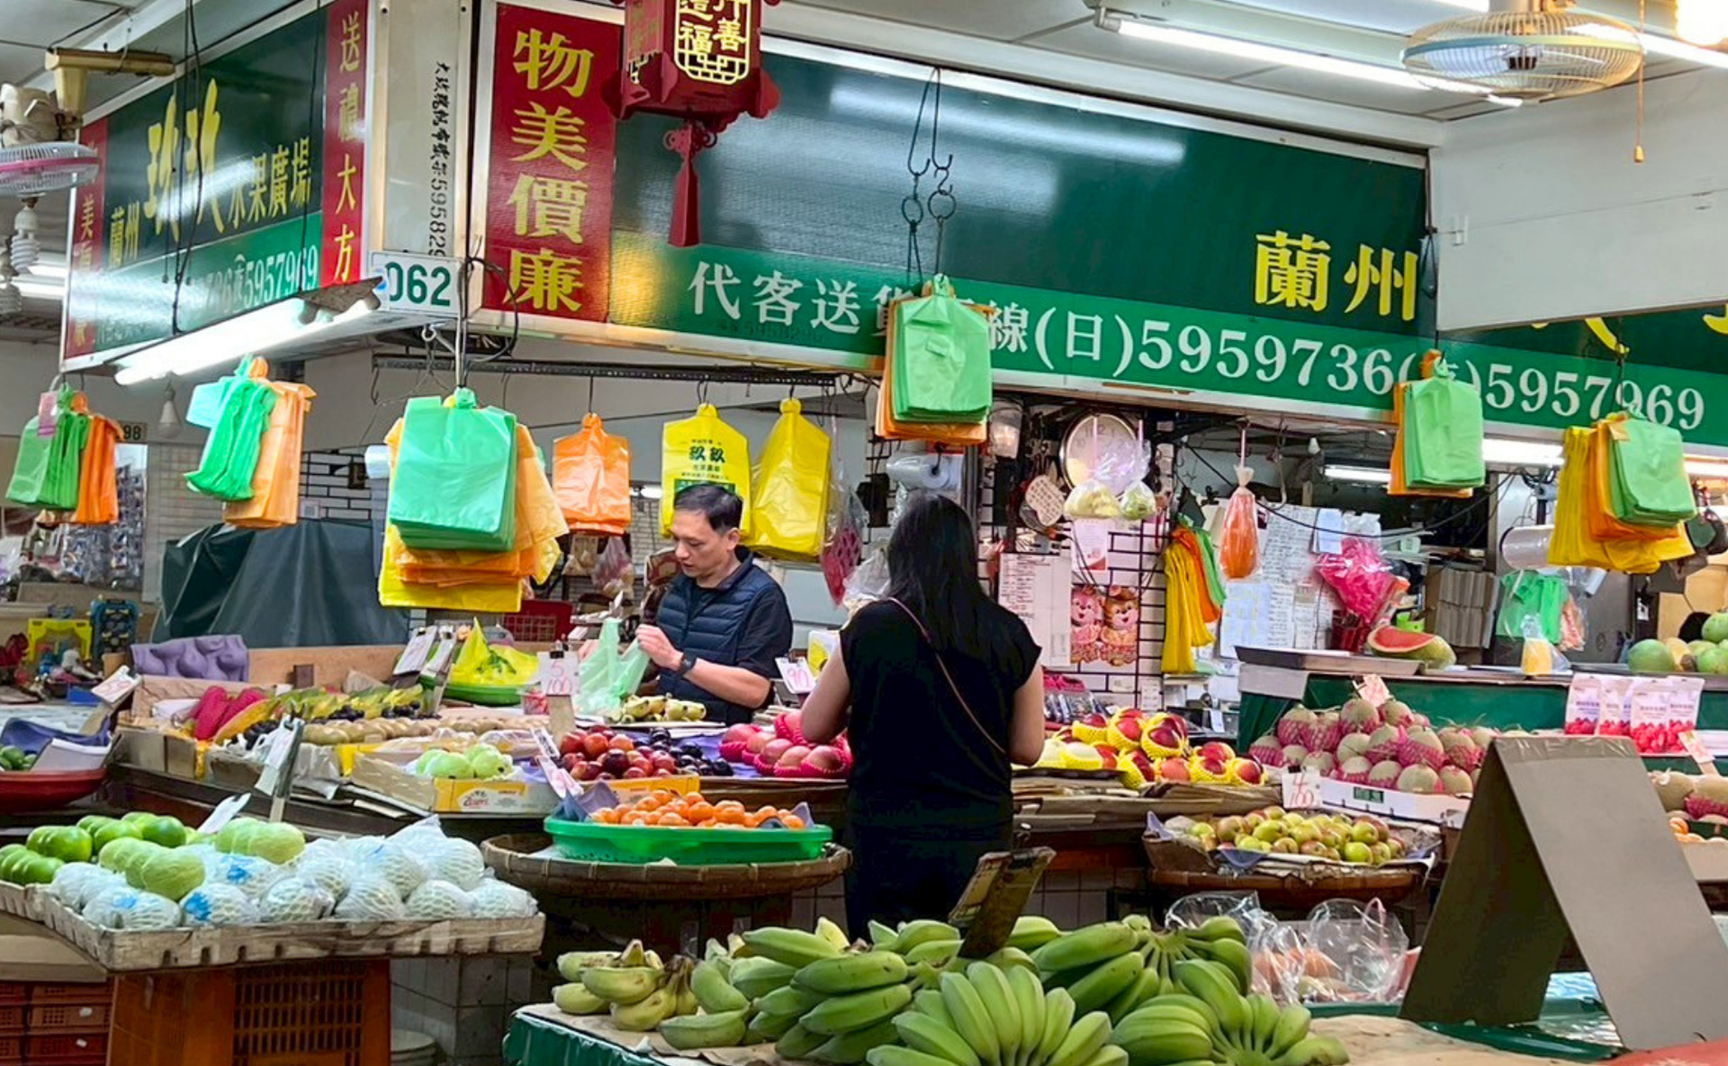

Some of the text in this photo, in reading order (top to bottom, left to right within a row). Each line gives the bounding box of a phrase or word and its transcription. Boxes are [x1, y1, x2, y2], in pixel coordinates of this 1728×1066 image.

[333, 10, 362, 283] 送禮大方
[502, 27, 595, 313] 物美價廉
[109, 200, 141, 269] 蘭州
[1254, 229, 1419, 322] 蘭州
[384, 260, 451, 307] 062
